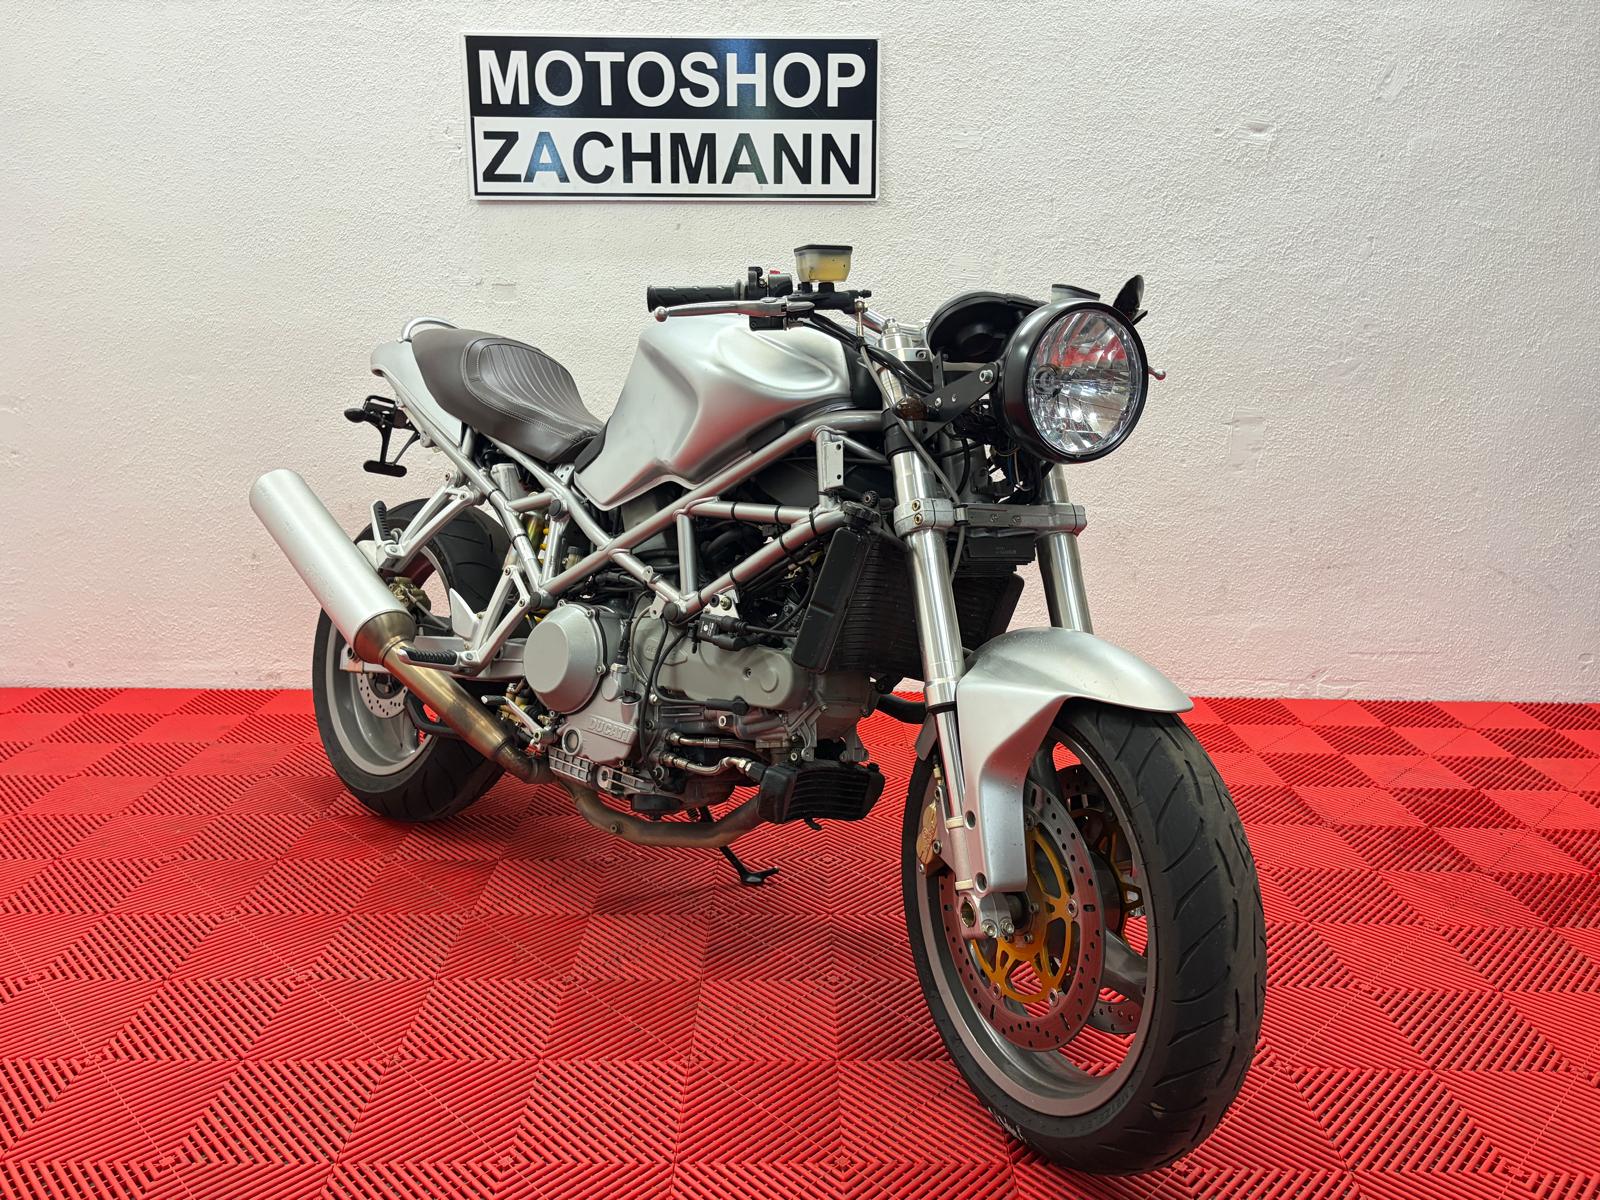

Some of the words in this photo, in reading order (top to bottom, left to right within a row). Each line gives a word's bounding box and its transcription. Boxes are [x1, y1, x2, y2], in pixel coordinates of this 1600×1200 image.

[478, 49, 866, 108] MOTOSHOP
[482, 130, 860, 185] ZACHMANN
[590, 717, 631, 743] DUCATI
